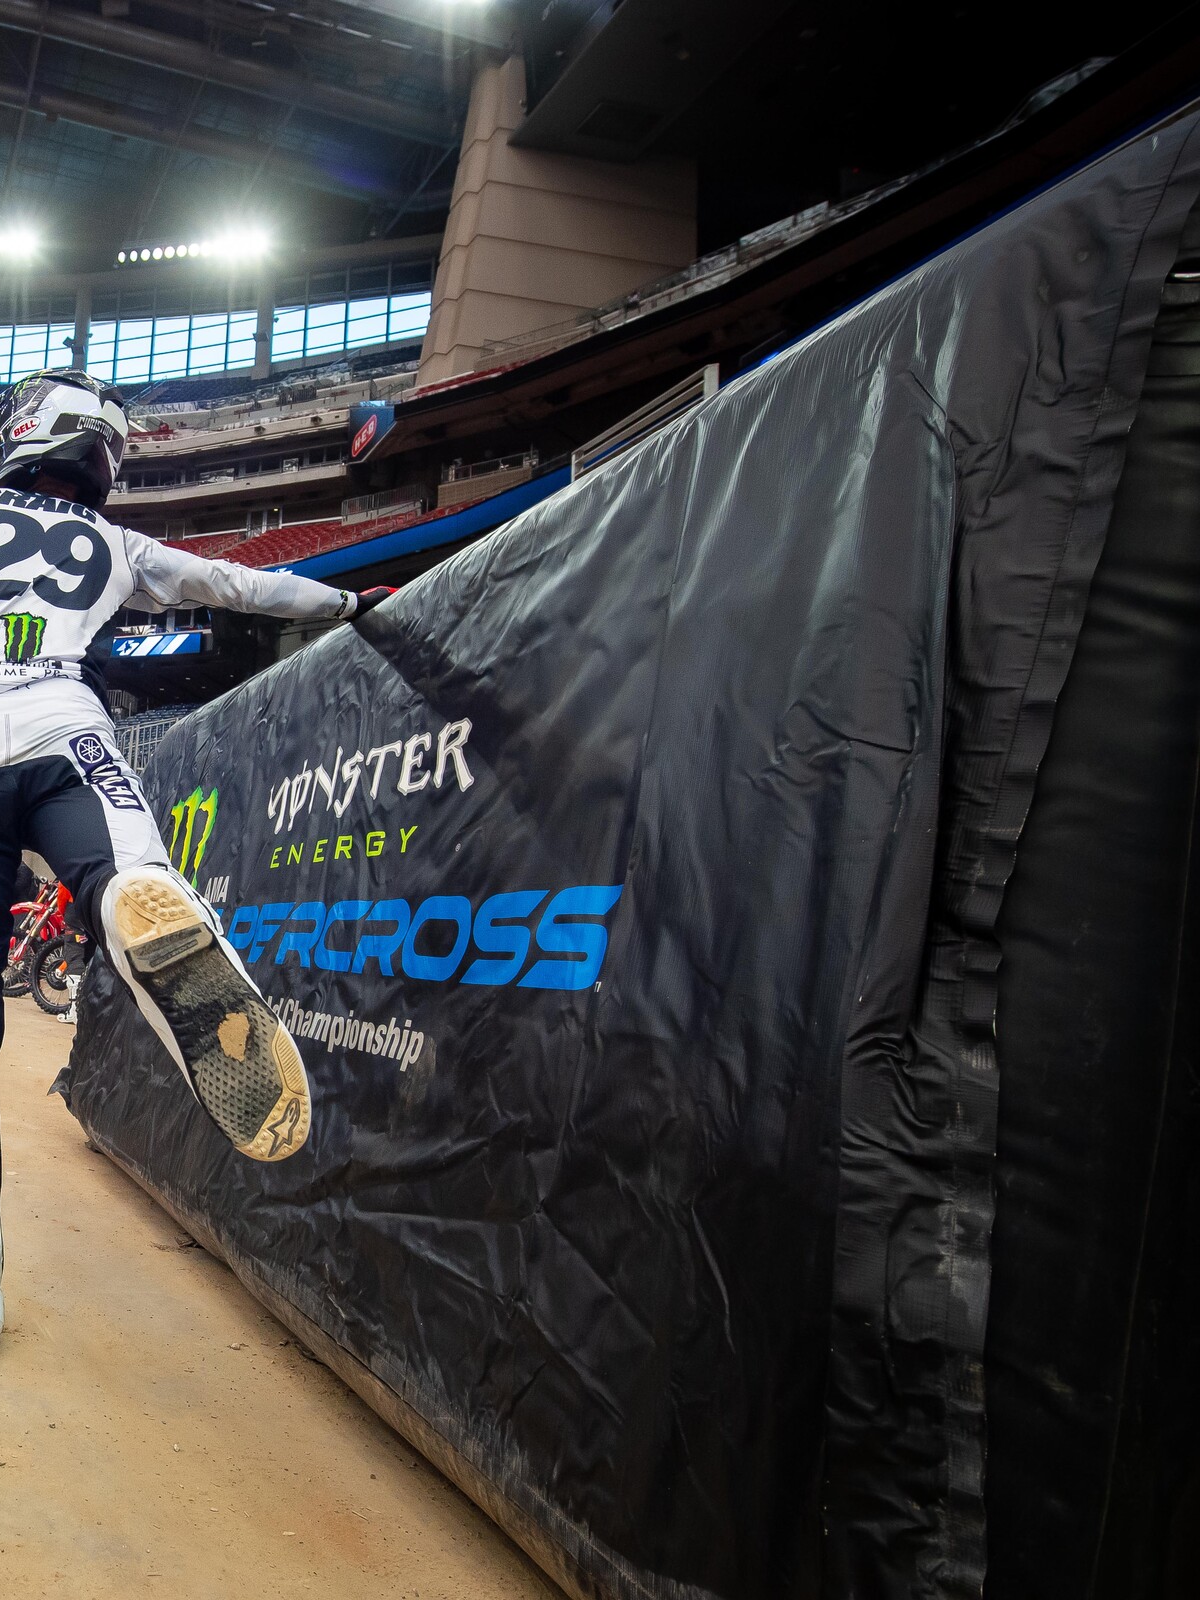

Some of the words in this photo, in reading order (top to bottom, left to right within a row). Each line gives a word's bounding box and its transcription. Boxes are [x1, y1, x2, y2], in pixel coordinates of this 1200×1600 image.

[13, 420, 37, 438] BELL
[267, 718, 475, 835] MONSTER
[270, 825, 418, 869] ENERGY
[204, 875, 230, 904] AMA
[217, 884, 625, 991] PERCROSS
[282, 998, 425, 1072] Championship
